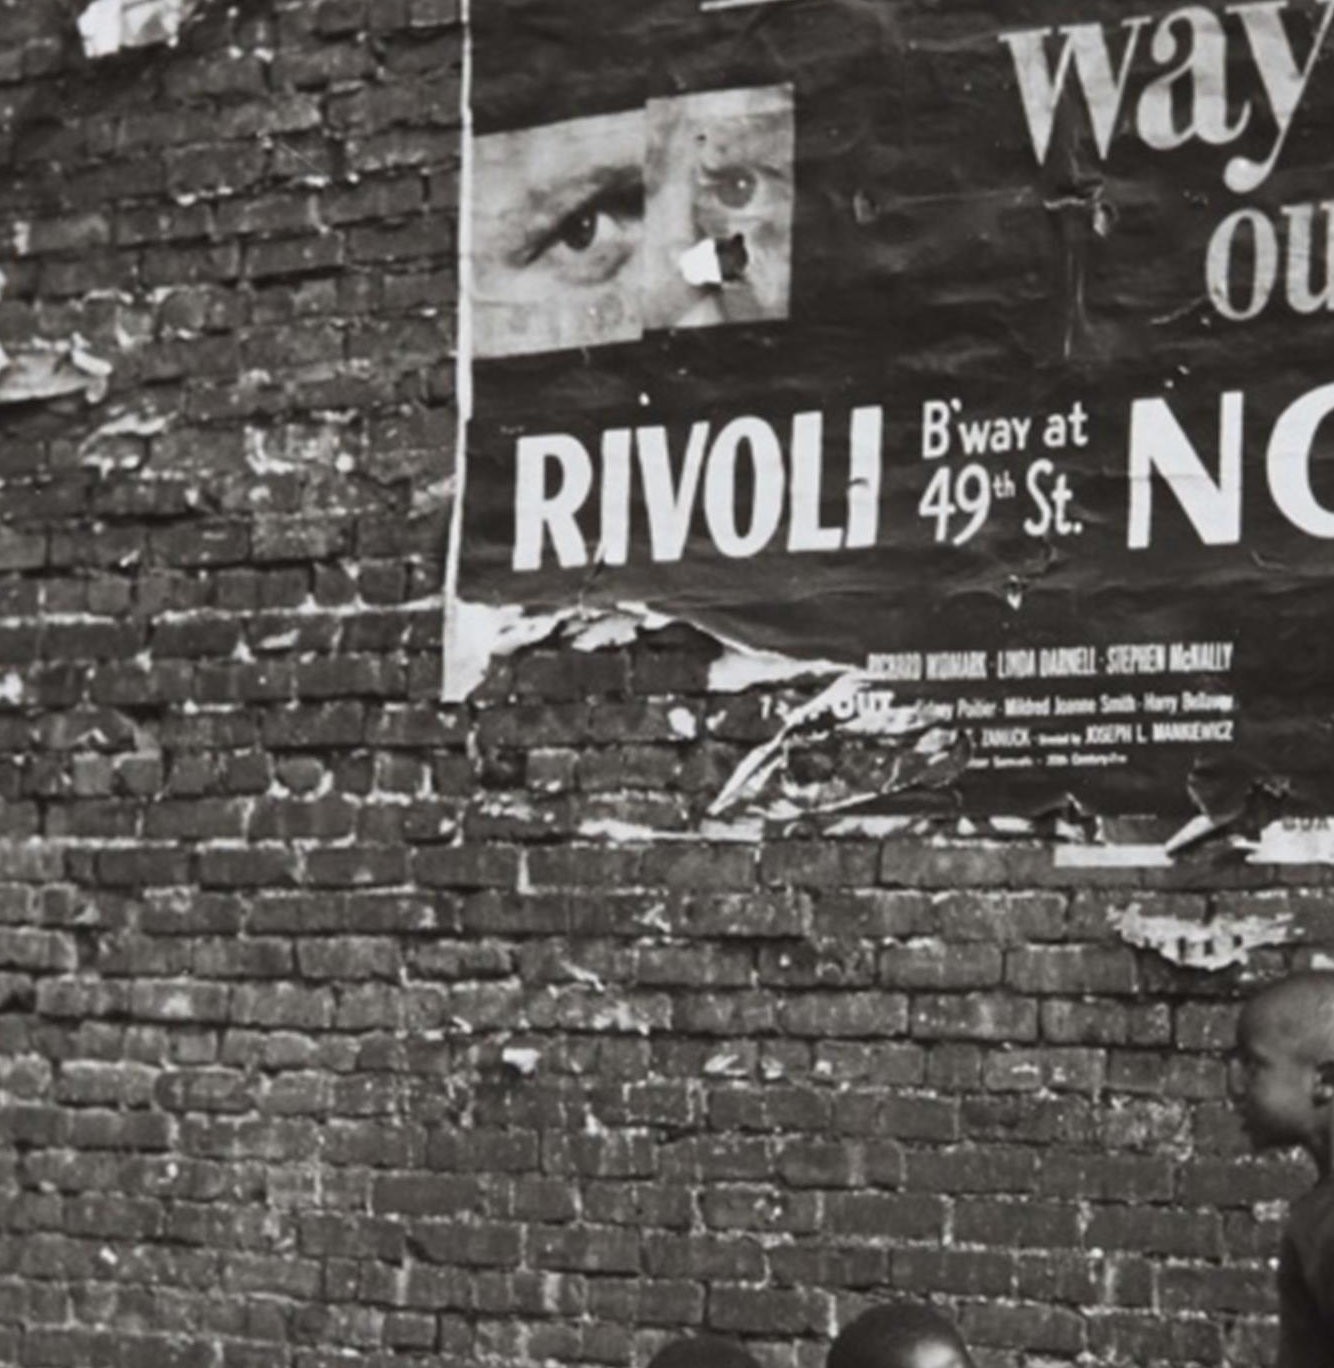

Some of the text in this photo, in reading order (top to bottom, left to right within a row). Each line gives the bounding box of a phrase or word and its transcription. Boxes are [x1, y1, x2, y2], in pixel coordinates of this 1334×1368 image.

[921, 397, 1089, 460] B'way at
[511, 405, 884, 573] RIVOLI
[918, 459, 1084, 546] 49th St.
[997, 648, 1036, 679] LINDA
[1039, 645, 1097, 678] DARNELL
[1105, 643, 1166, 676] STEPHEN
[1169, 641, 1234, 673] McNALLY
[1085, 722, 1133, 745] JOSEPH
